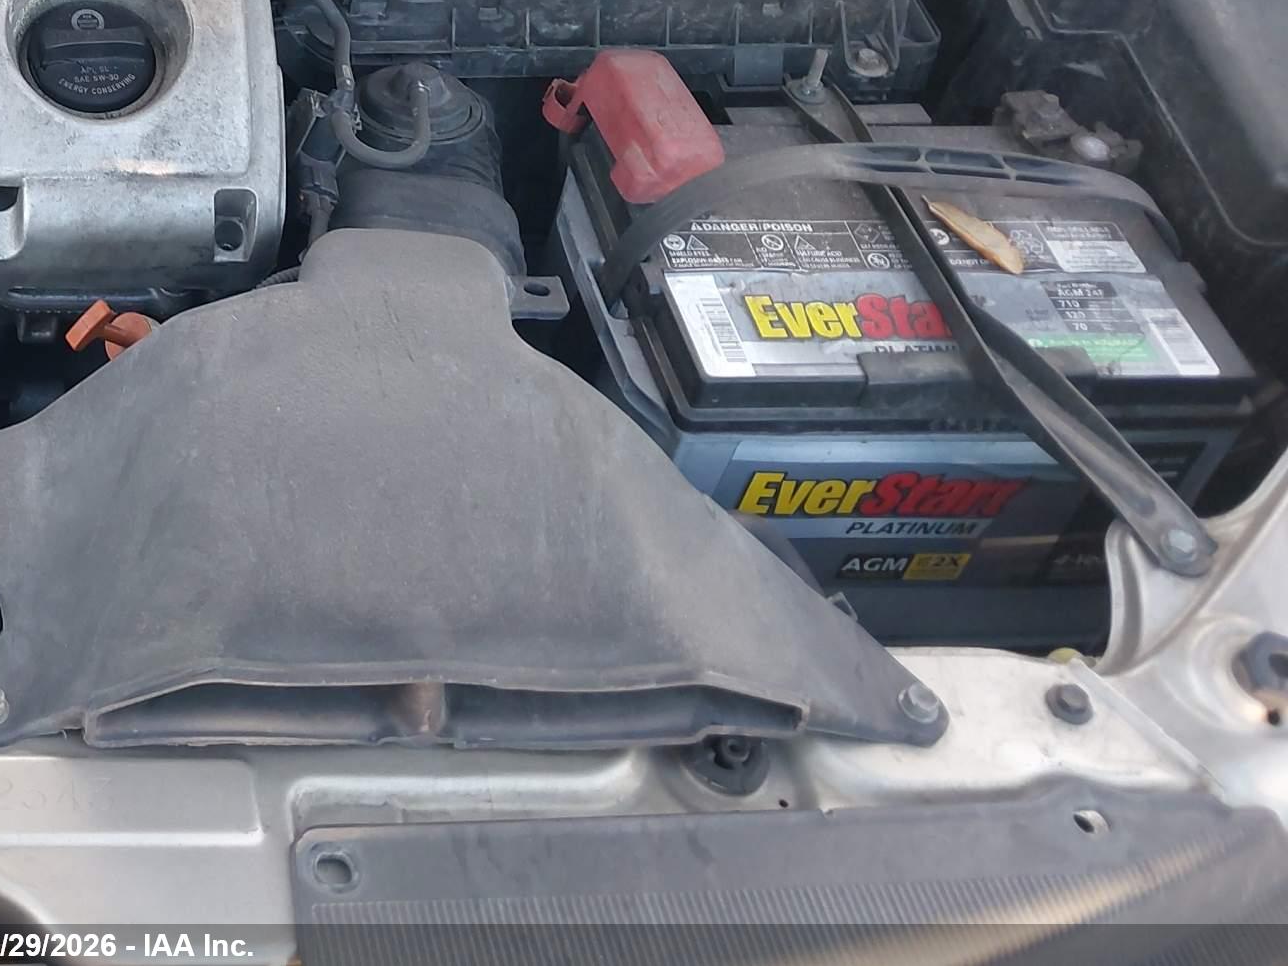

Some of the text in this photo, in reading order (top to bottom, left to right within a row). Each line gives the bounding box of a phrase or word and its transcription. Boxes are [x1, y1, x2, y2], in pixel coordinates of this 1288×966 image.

[58, 73, 136, 95] ENERGY CONSERVING
[74, 75, 90, 83] SAE
[702, 222, 813, 232] DANGER/POISON
[744, 293, 952, 340] EverSta
[845, 521, 978, 535] PLATINUM
[841, 557, 908, 572] AGM
